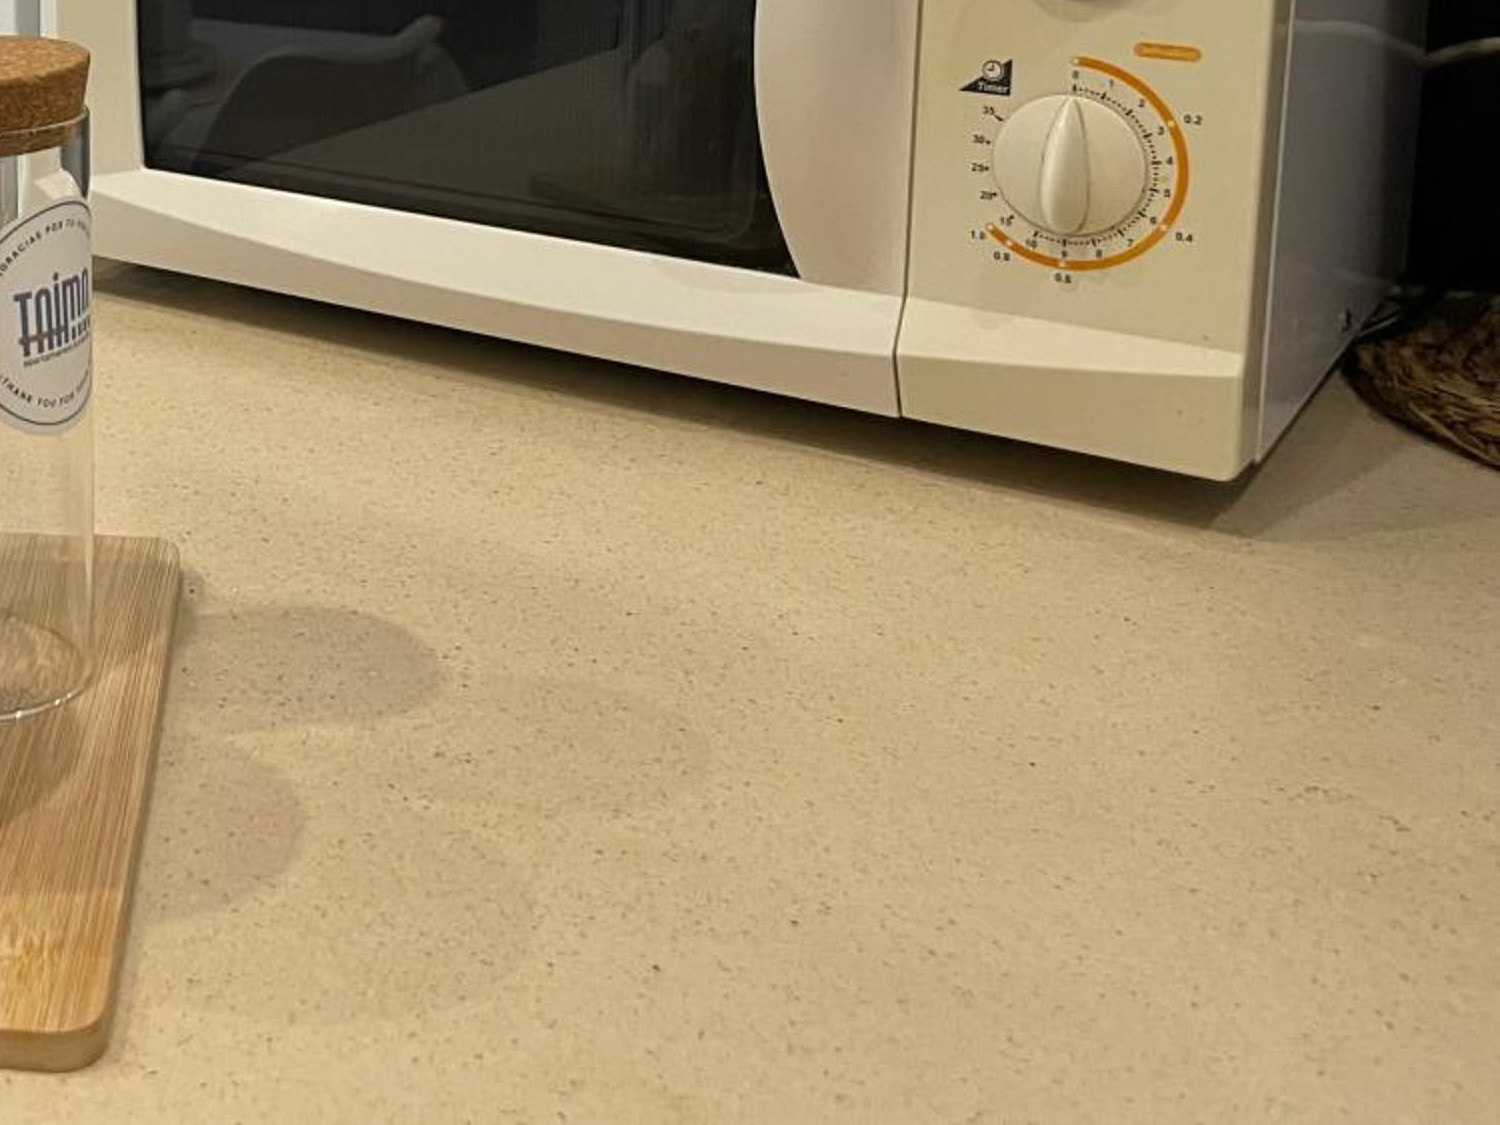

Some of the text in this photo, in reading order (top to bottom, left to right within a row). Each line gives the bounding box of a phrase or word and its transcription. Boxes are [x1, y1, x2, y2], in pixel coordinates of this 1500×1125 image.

[977, 81, 1010, 93] Timer
[1184, 114, 1203, 125] 0.2
[1175, 232, 1194, 243] 0.4
